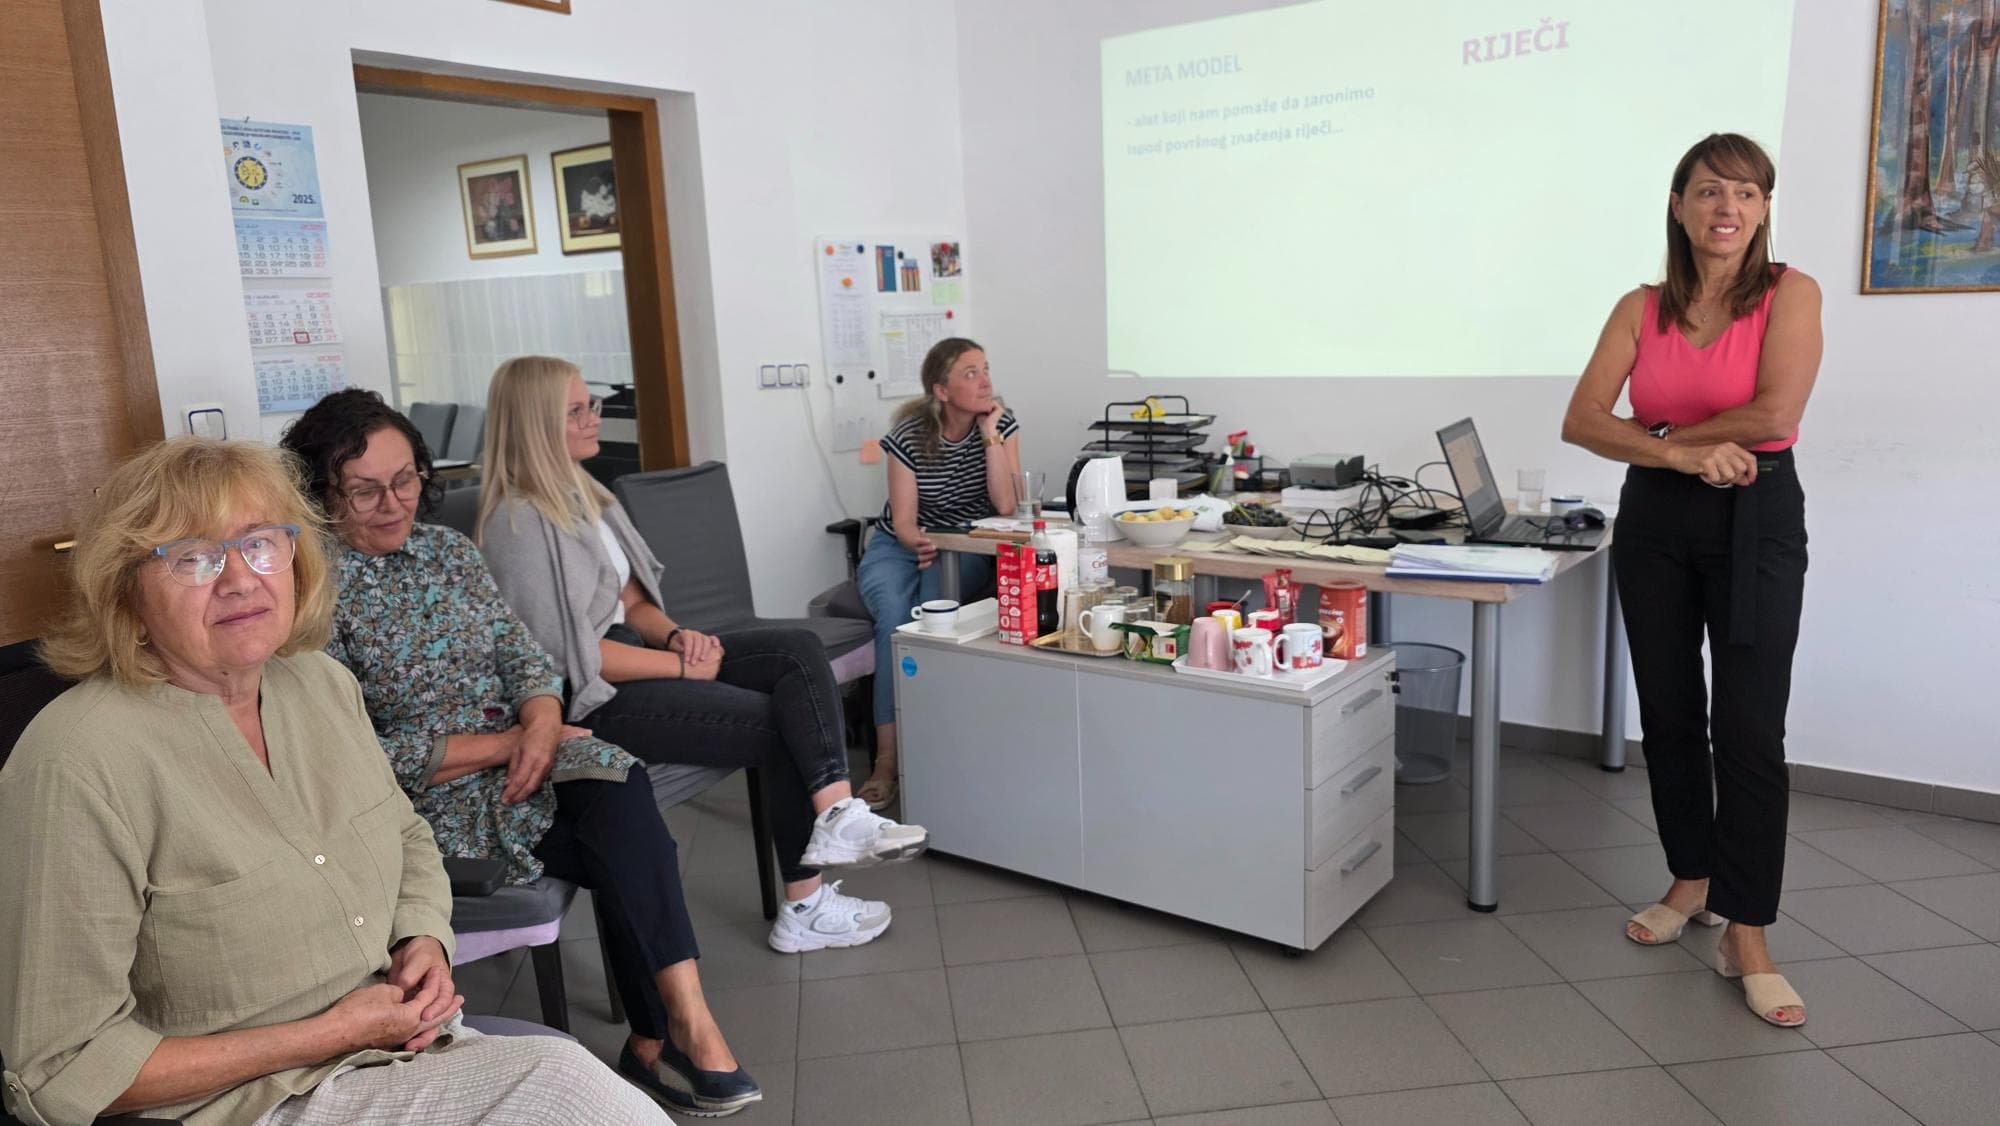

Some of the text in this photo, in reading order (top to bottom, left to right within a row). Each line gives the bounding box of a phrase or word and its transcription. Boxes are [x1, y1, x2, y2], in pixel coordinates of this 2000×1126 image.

[1463, 17, 1570, 65] RIJEČI
[1125, 54, 1243, 87] META MODEL
[1190, 108, 1219, 122] nam
[1223, 96, 1278, 121] pomaže
[1281, 95, 1300, 112] da
[1304, 86, 1376, 109] zaronimo
[1166, 133, 1227, 157] površnog
[1231, 125, 1292, 146] značenja
